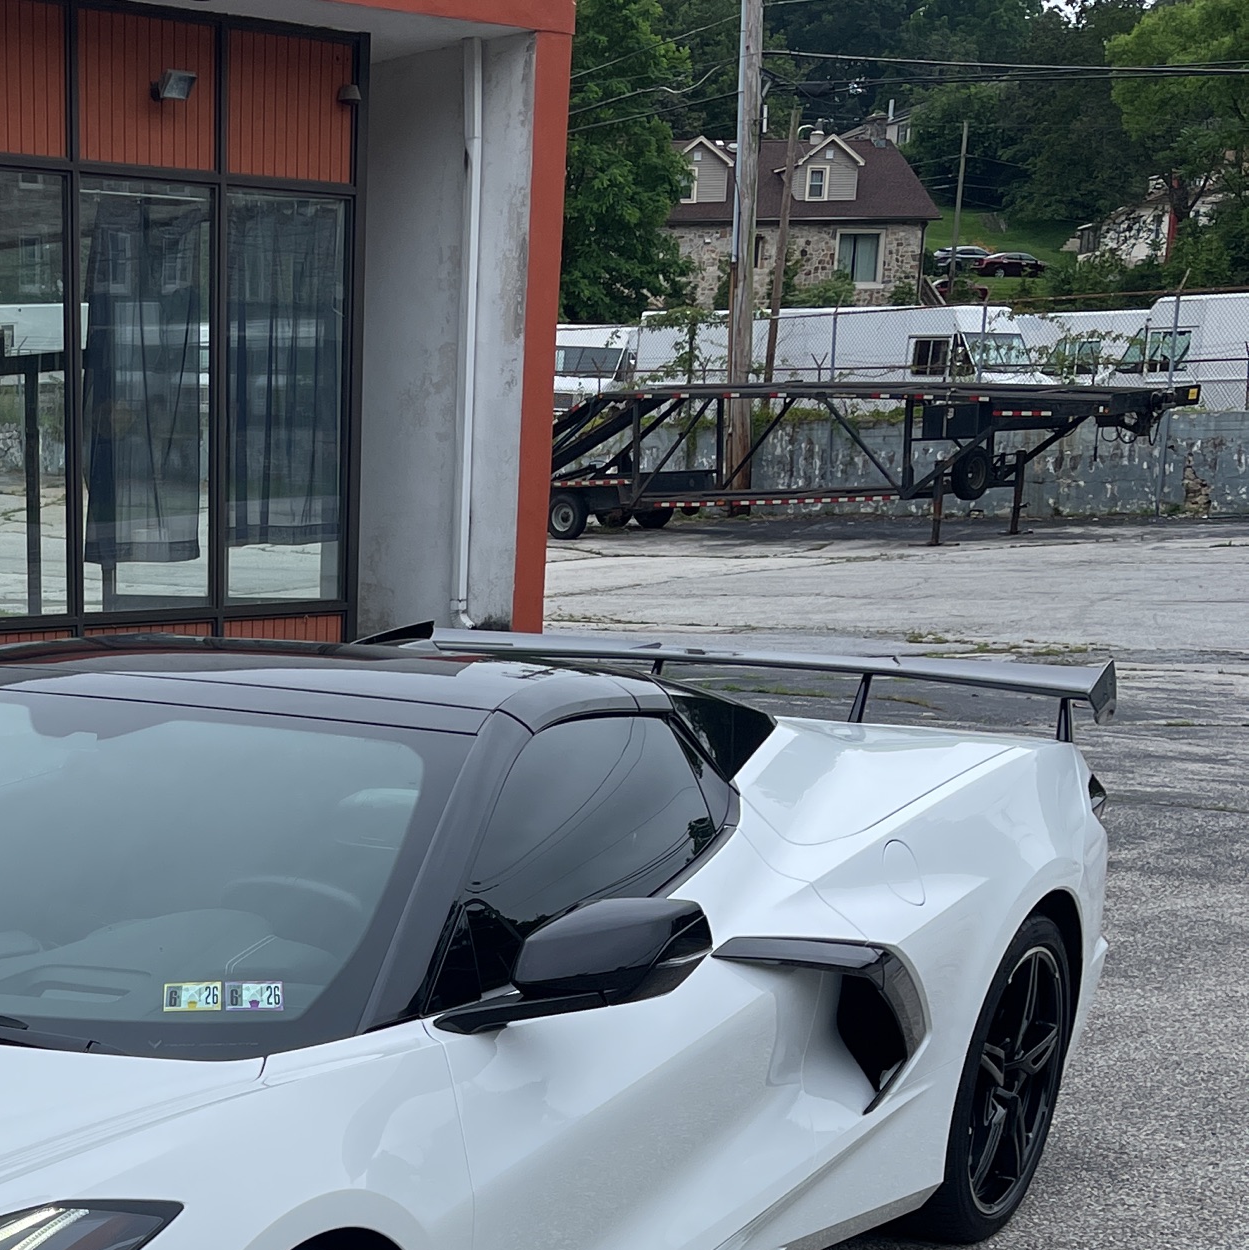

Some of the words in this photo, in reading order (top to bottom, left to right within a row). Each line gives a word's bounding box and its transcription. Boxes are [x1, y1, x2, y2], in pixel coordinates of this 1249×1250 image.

[169, 990, 178, 1007] 6
[205, 986, 219, 1005] 26
[230, 988, 239, 1006] 6
[266, 985, 281, 1005] 26
